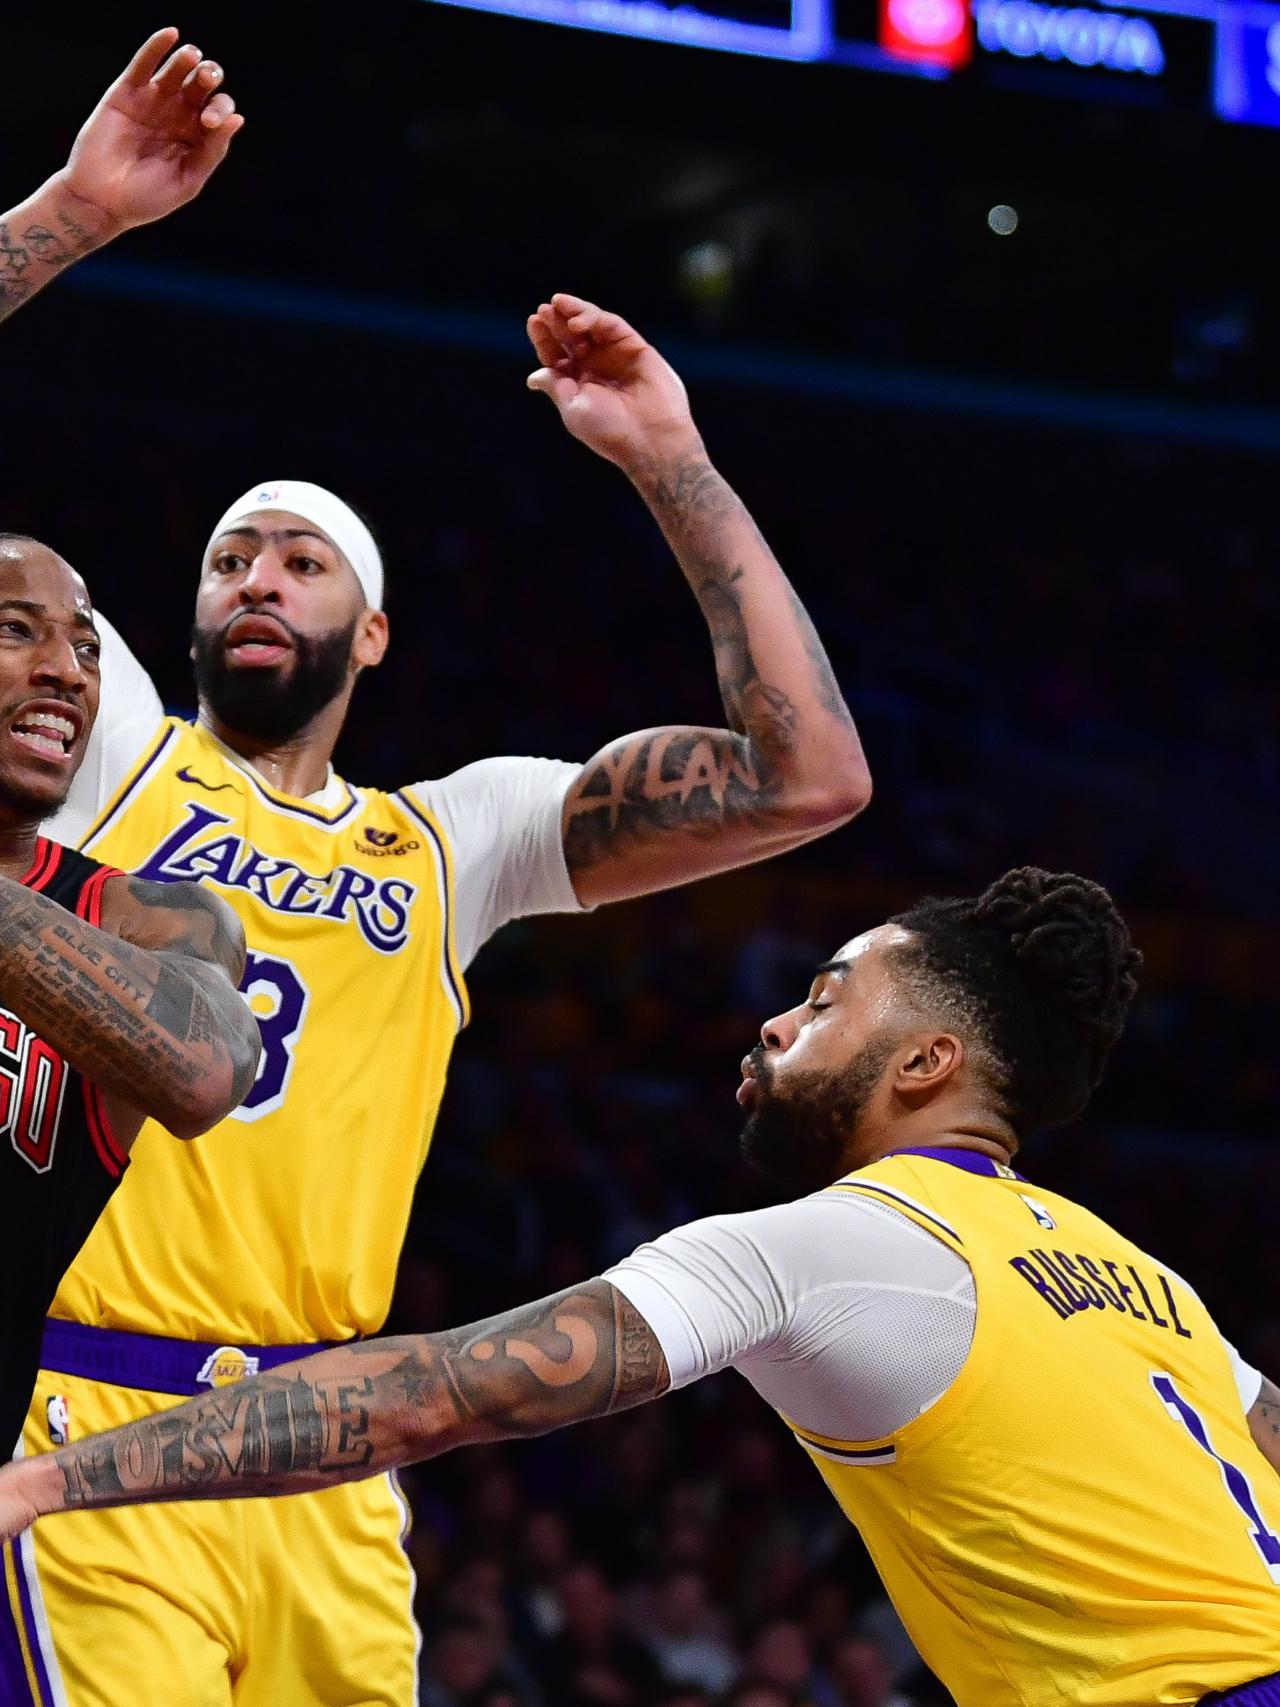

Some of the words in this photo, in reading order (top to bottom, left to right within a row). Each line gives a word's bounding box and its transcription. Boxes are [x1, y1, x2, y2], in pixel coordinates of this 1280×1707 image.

[136, 802, 417, 956] LAKERS
[1008, 1248, 1193, 1340] RUSSELL
[1147, 1369, 1280, 1585] 1
